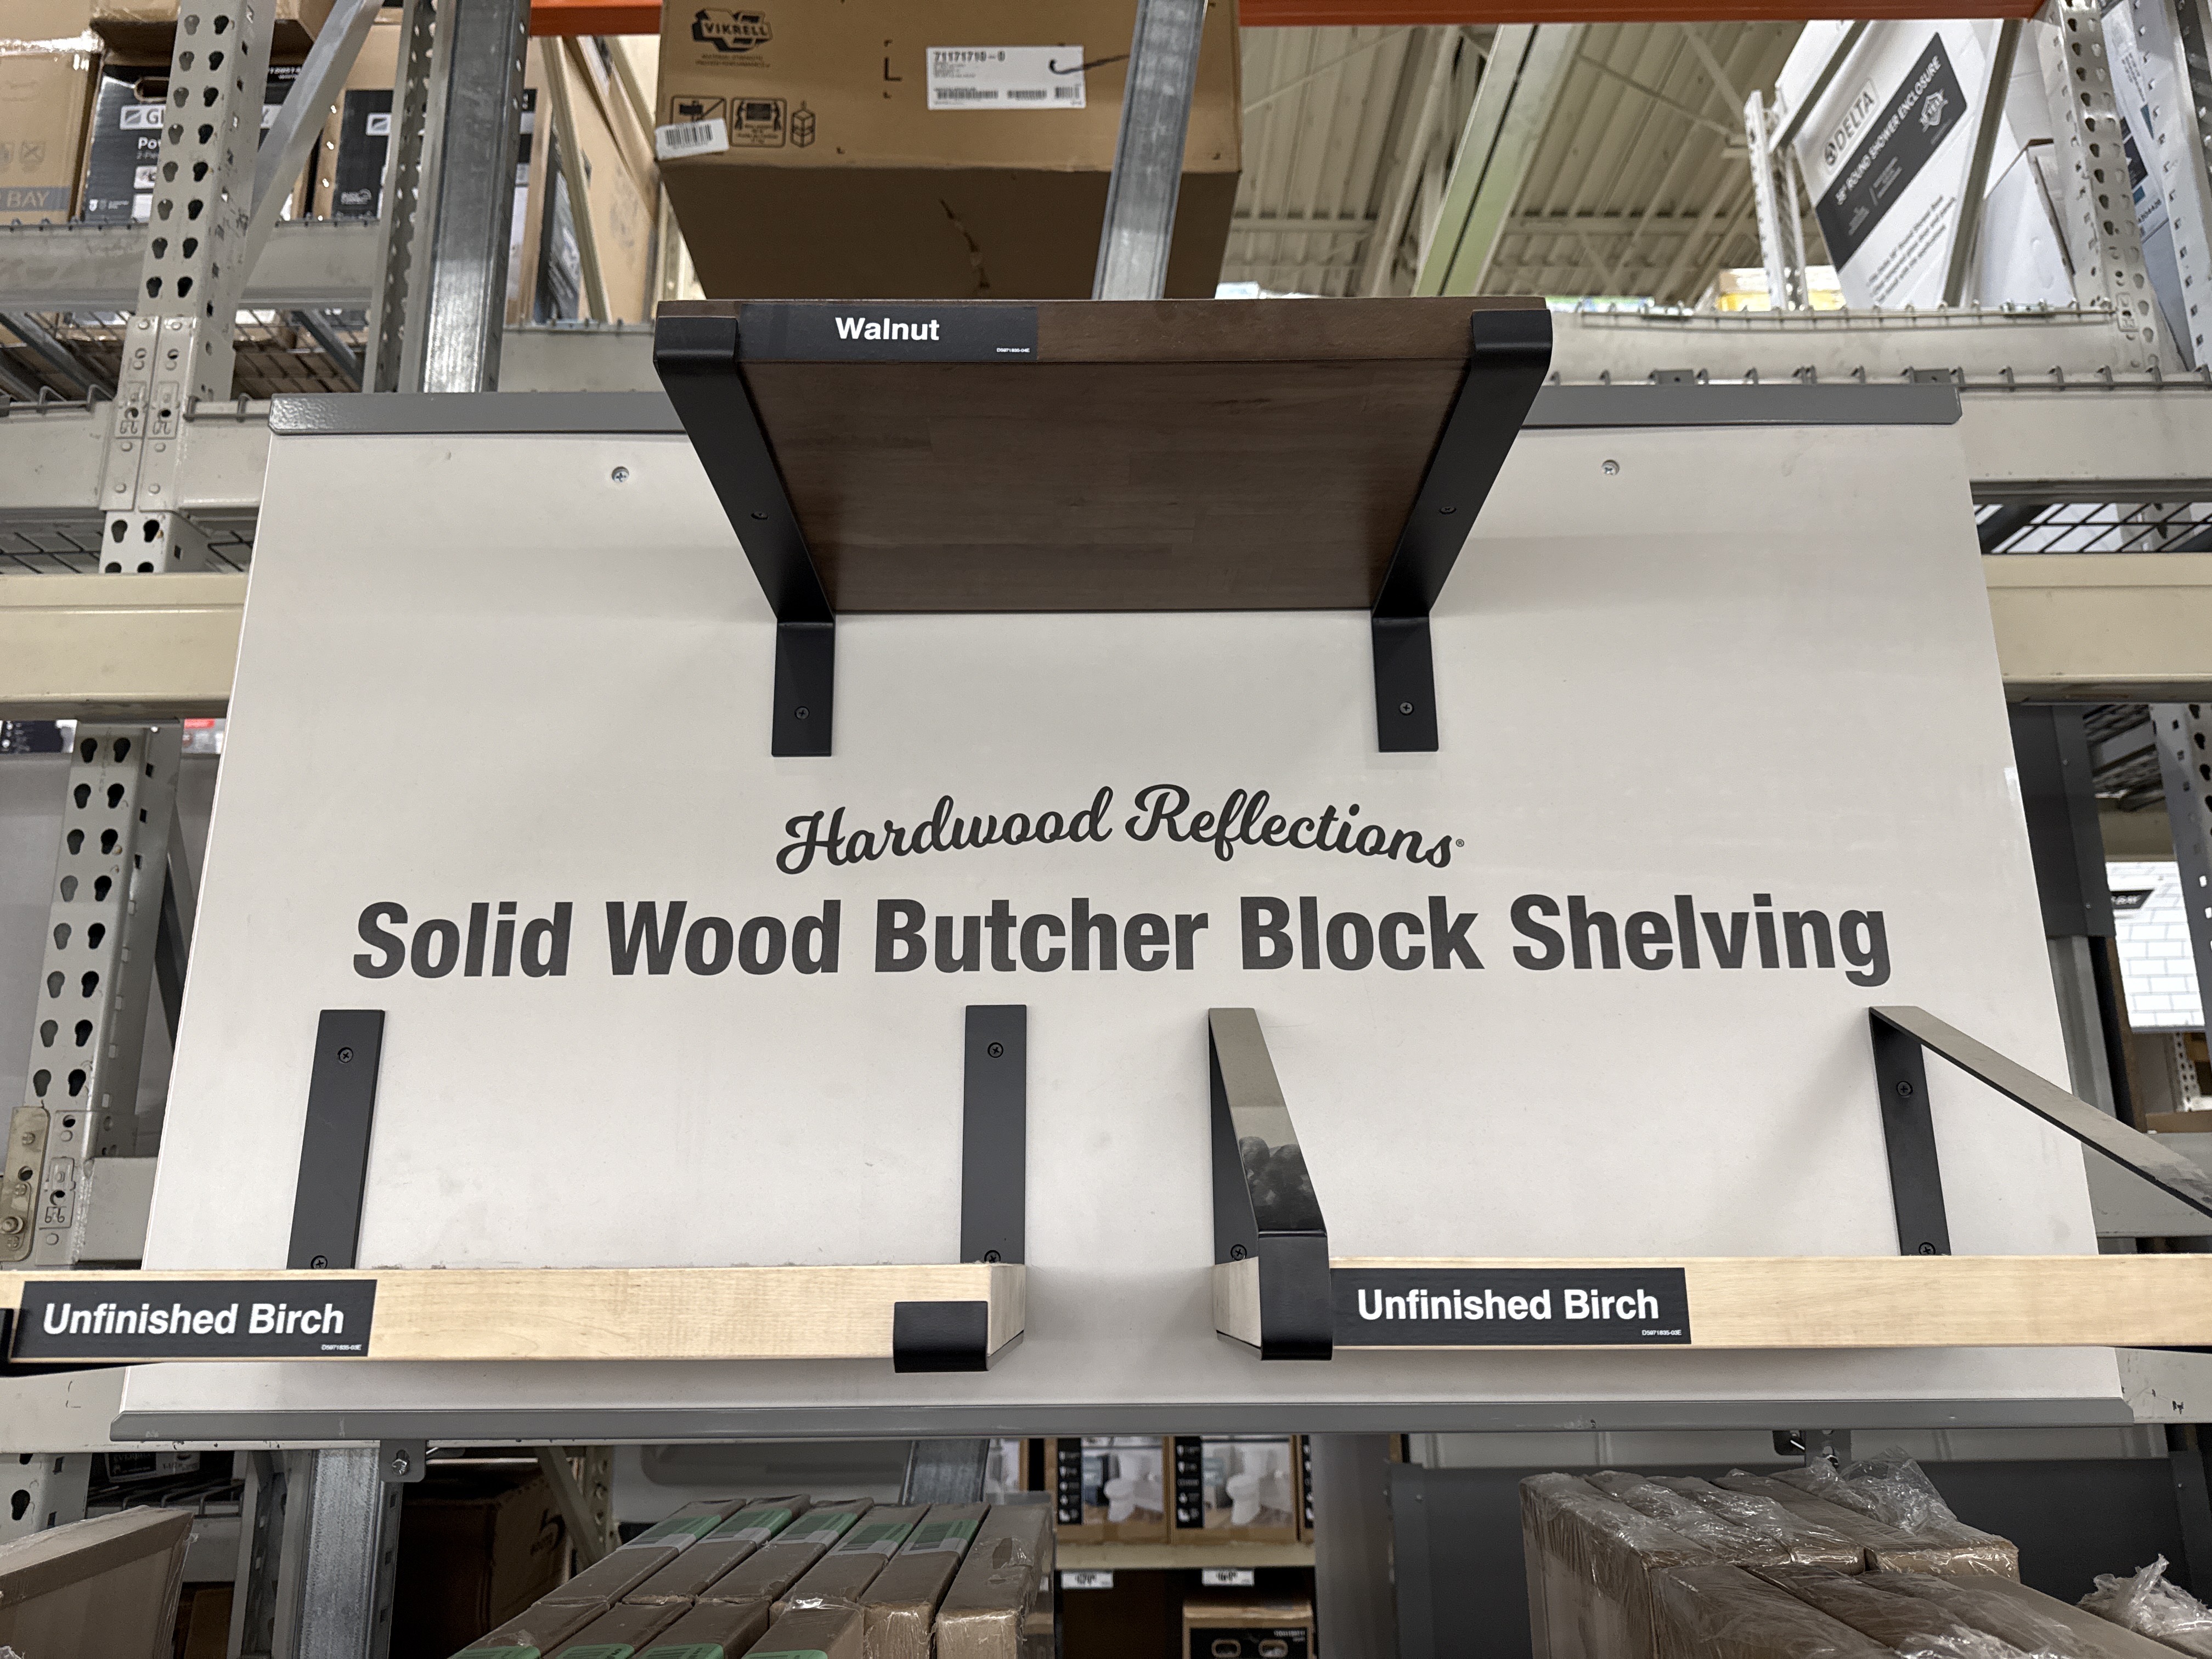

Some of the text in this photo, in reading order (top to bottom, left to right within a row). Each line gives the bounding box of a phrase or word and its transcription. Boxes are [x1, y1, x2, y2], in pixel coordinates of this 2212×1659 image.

[704, 22, 769, 36] VIKRELL
[1834, 91, 1875, 151] DELTA
[1846, 154, 1871, 190] ROUND
[1869, 114, 1900, 159] SHOWER
[1898, 55, 1942, 120] ENCLOSURE
[7, 190, 50, 207] BAY
[835, 317, 940, 341] Walnut
[776, 786, 1113, 875] Hardwood
[354, 893, 1891, 987] Solid Wood Butcher Block Shelving
[43, 1304, 344, 1335] Unfinished Birch
[1358, 1289, 1659, 1320] Unfinished Birch
